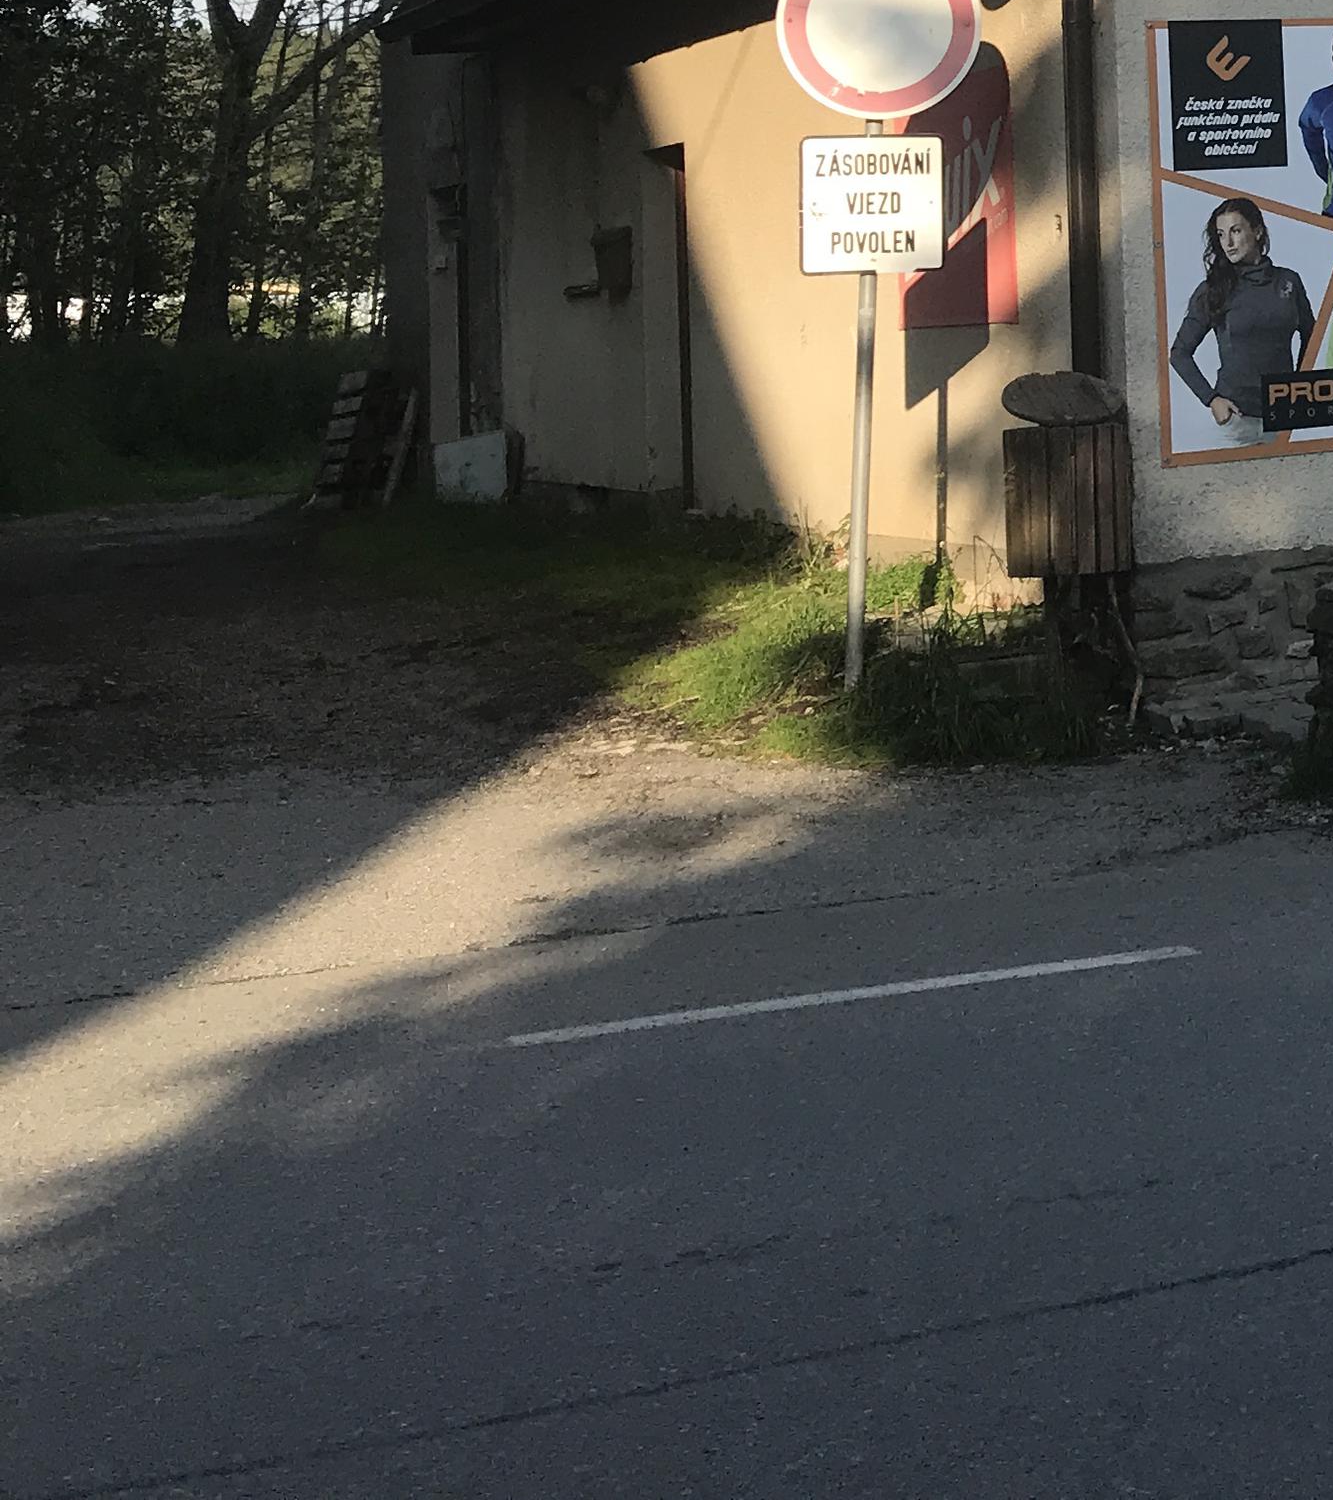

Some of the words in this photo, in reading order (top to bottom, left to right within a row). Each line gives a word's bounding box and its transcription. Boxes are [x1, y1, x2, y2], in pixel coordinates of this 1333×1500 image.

[1184, 97, 1224, 111] česká
[1226, 96, 1273, 110] značka
[1240, 111, 1281, 127] prádla
[1187, 131, 1197, 142] a
[1198, 127, 1272, 143] sportovního
[1204, 141, 1259, 156] oblečení
[816, 148, 931, 177] ZÁSOBOVÁNÍ
[846, 192, 901, 215] VJEZD
[831, 230, 916, 254] POVOLEN
